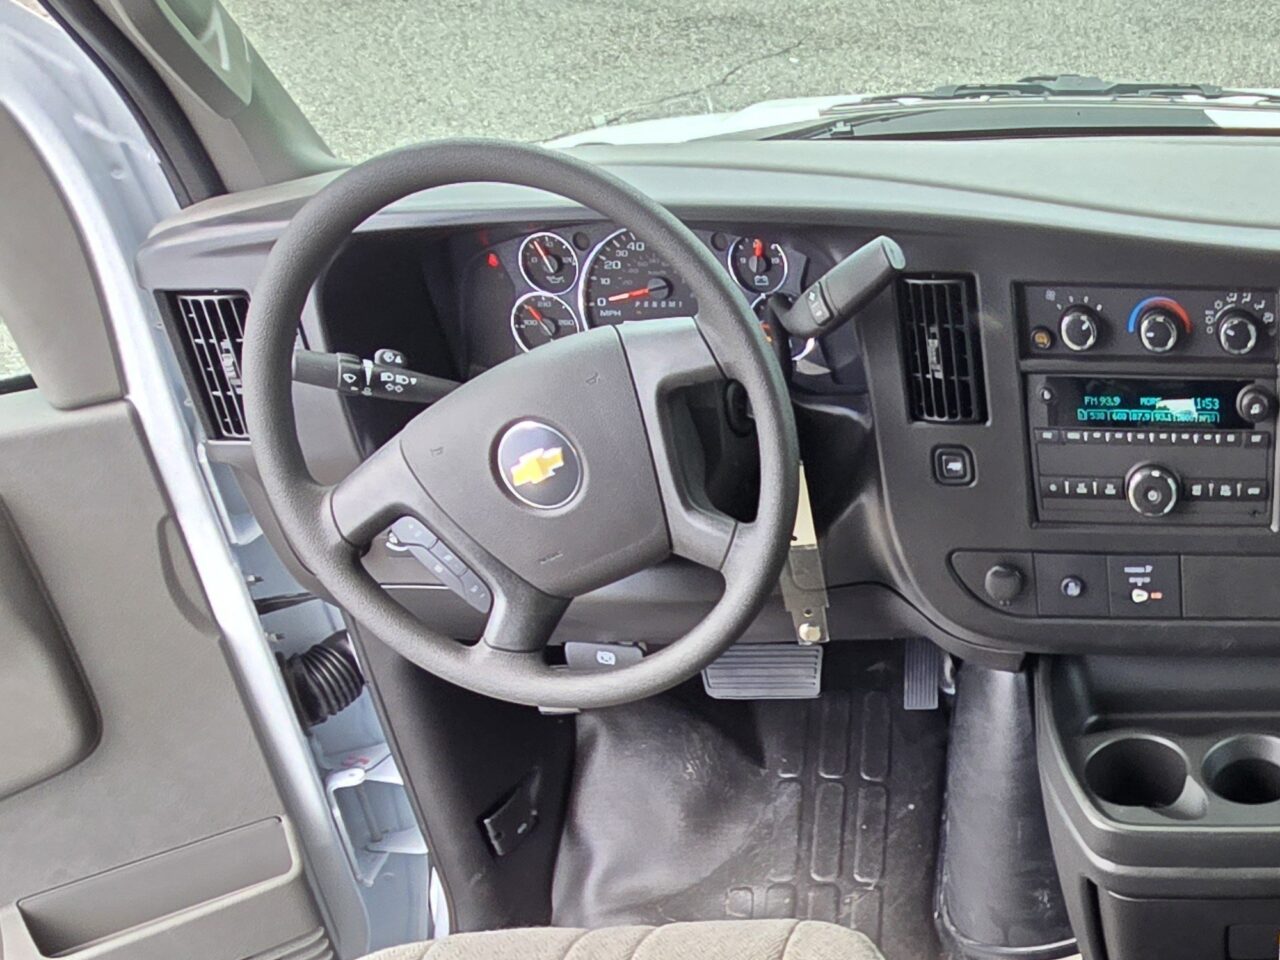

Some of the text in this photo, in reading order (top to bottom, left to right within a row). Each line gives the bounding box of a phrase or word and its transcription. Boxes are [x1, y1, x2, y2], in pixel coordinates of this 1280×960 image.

[626, 242, 645, 251] 40
[604, 260, 621, 269] 20
[597, 298, 606, 306] 0
[1084, 396, 1098, 406] FM
